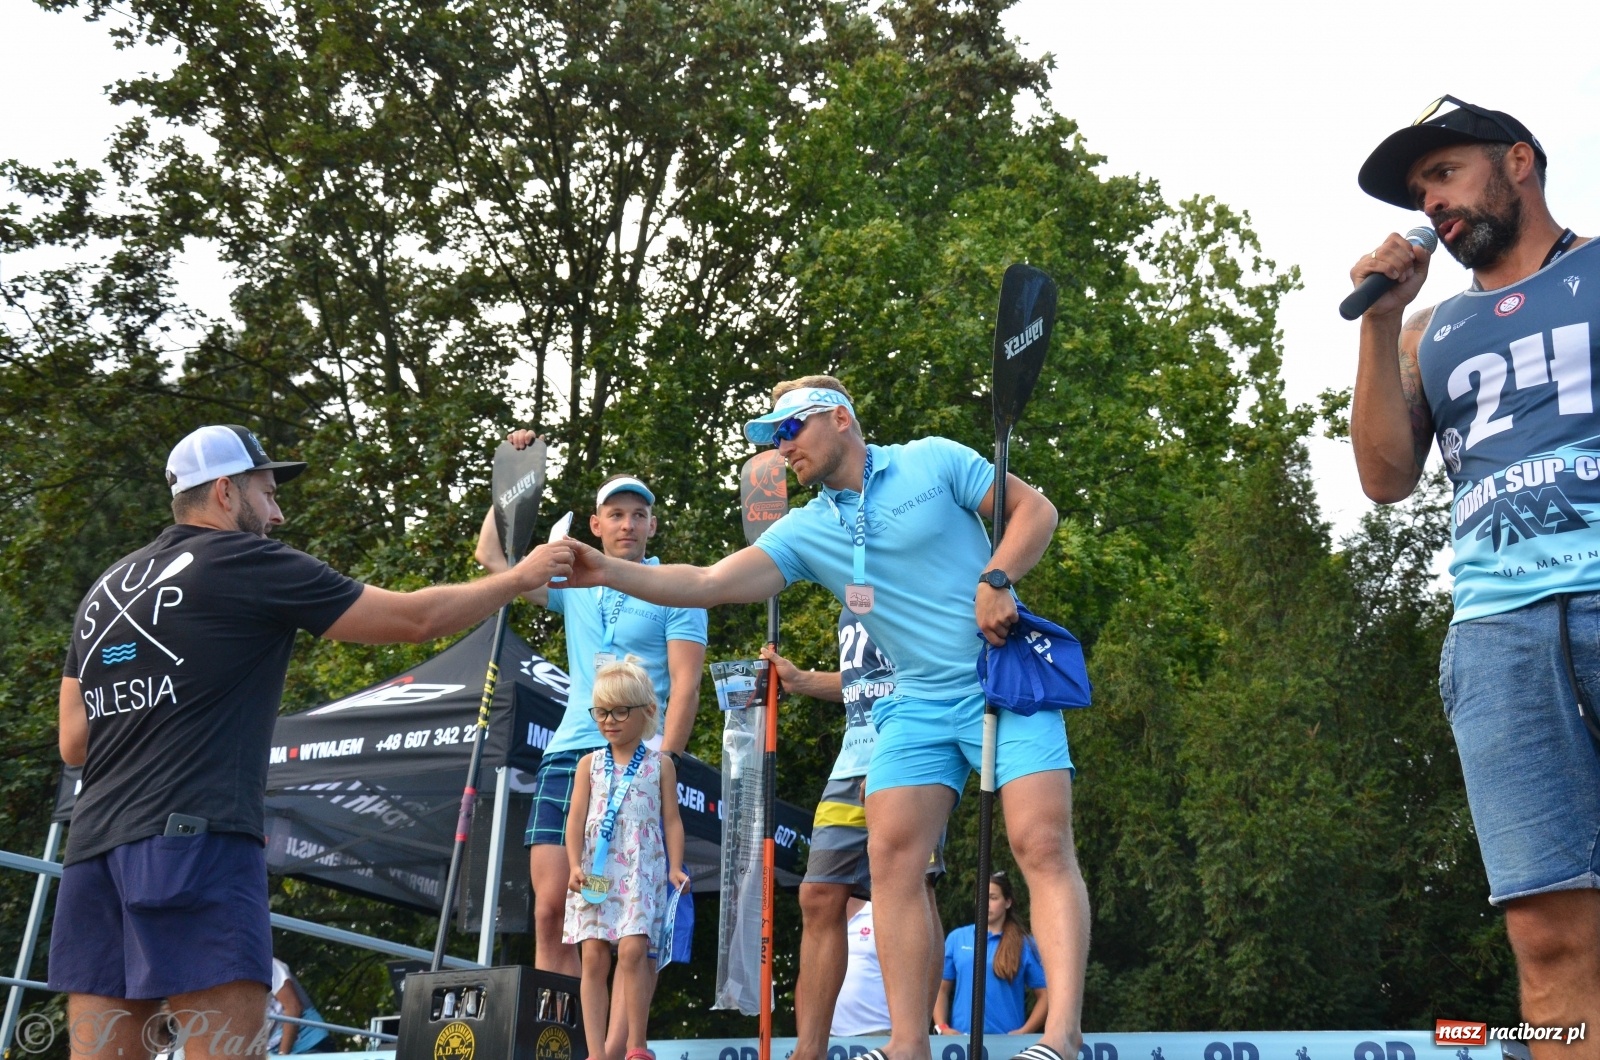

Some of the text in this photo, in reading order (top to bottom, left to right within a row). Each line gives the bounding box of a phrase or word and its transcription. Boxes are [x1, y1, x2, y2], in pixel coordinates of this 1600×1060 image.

[1447, 322, 1594, 451] 24
[891, 485, 943, 518] PIOTR KULETA
[1457, 475, 1498, 527] ODRA
[1505, 458, 1565, 493] SUP
[853, 502, 867, 547] ODRA
[84, 675, 177, 720] SILESIA
[864, 681, 895, 698] CUP
[300, 738, 364, 761] WYNAJEM
[375, 733, 402, 752] +48
[404, 730, 431, 750] 607
[433, 726, 460, 746] 342
[599, 744, 647, 843] ODRA SUP CUP
